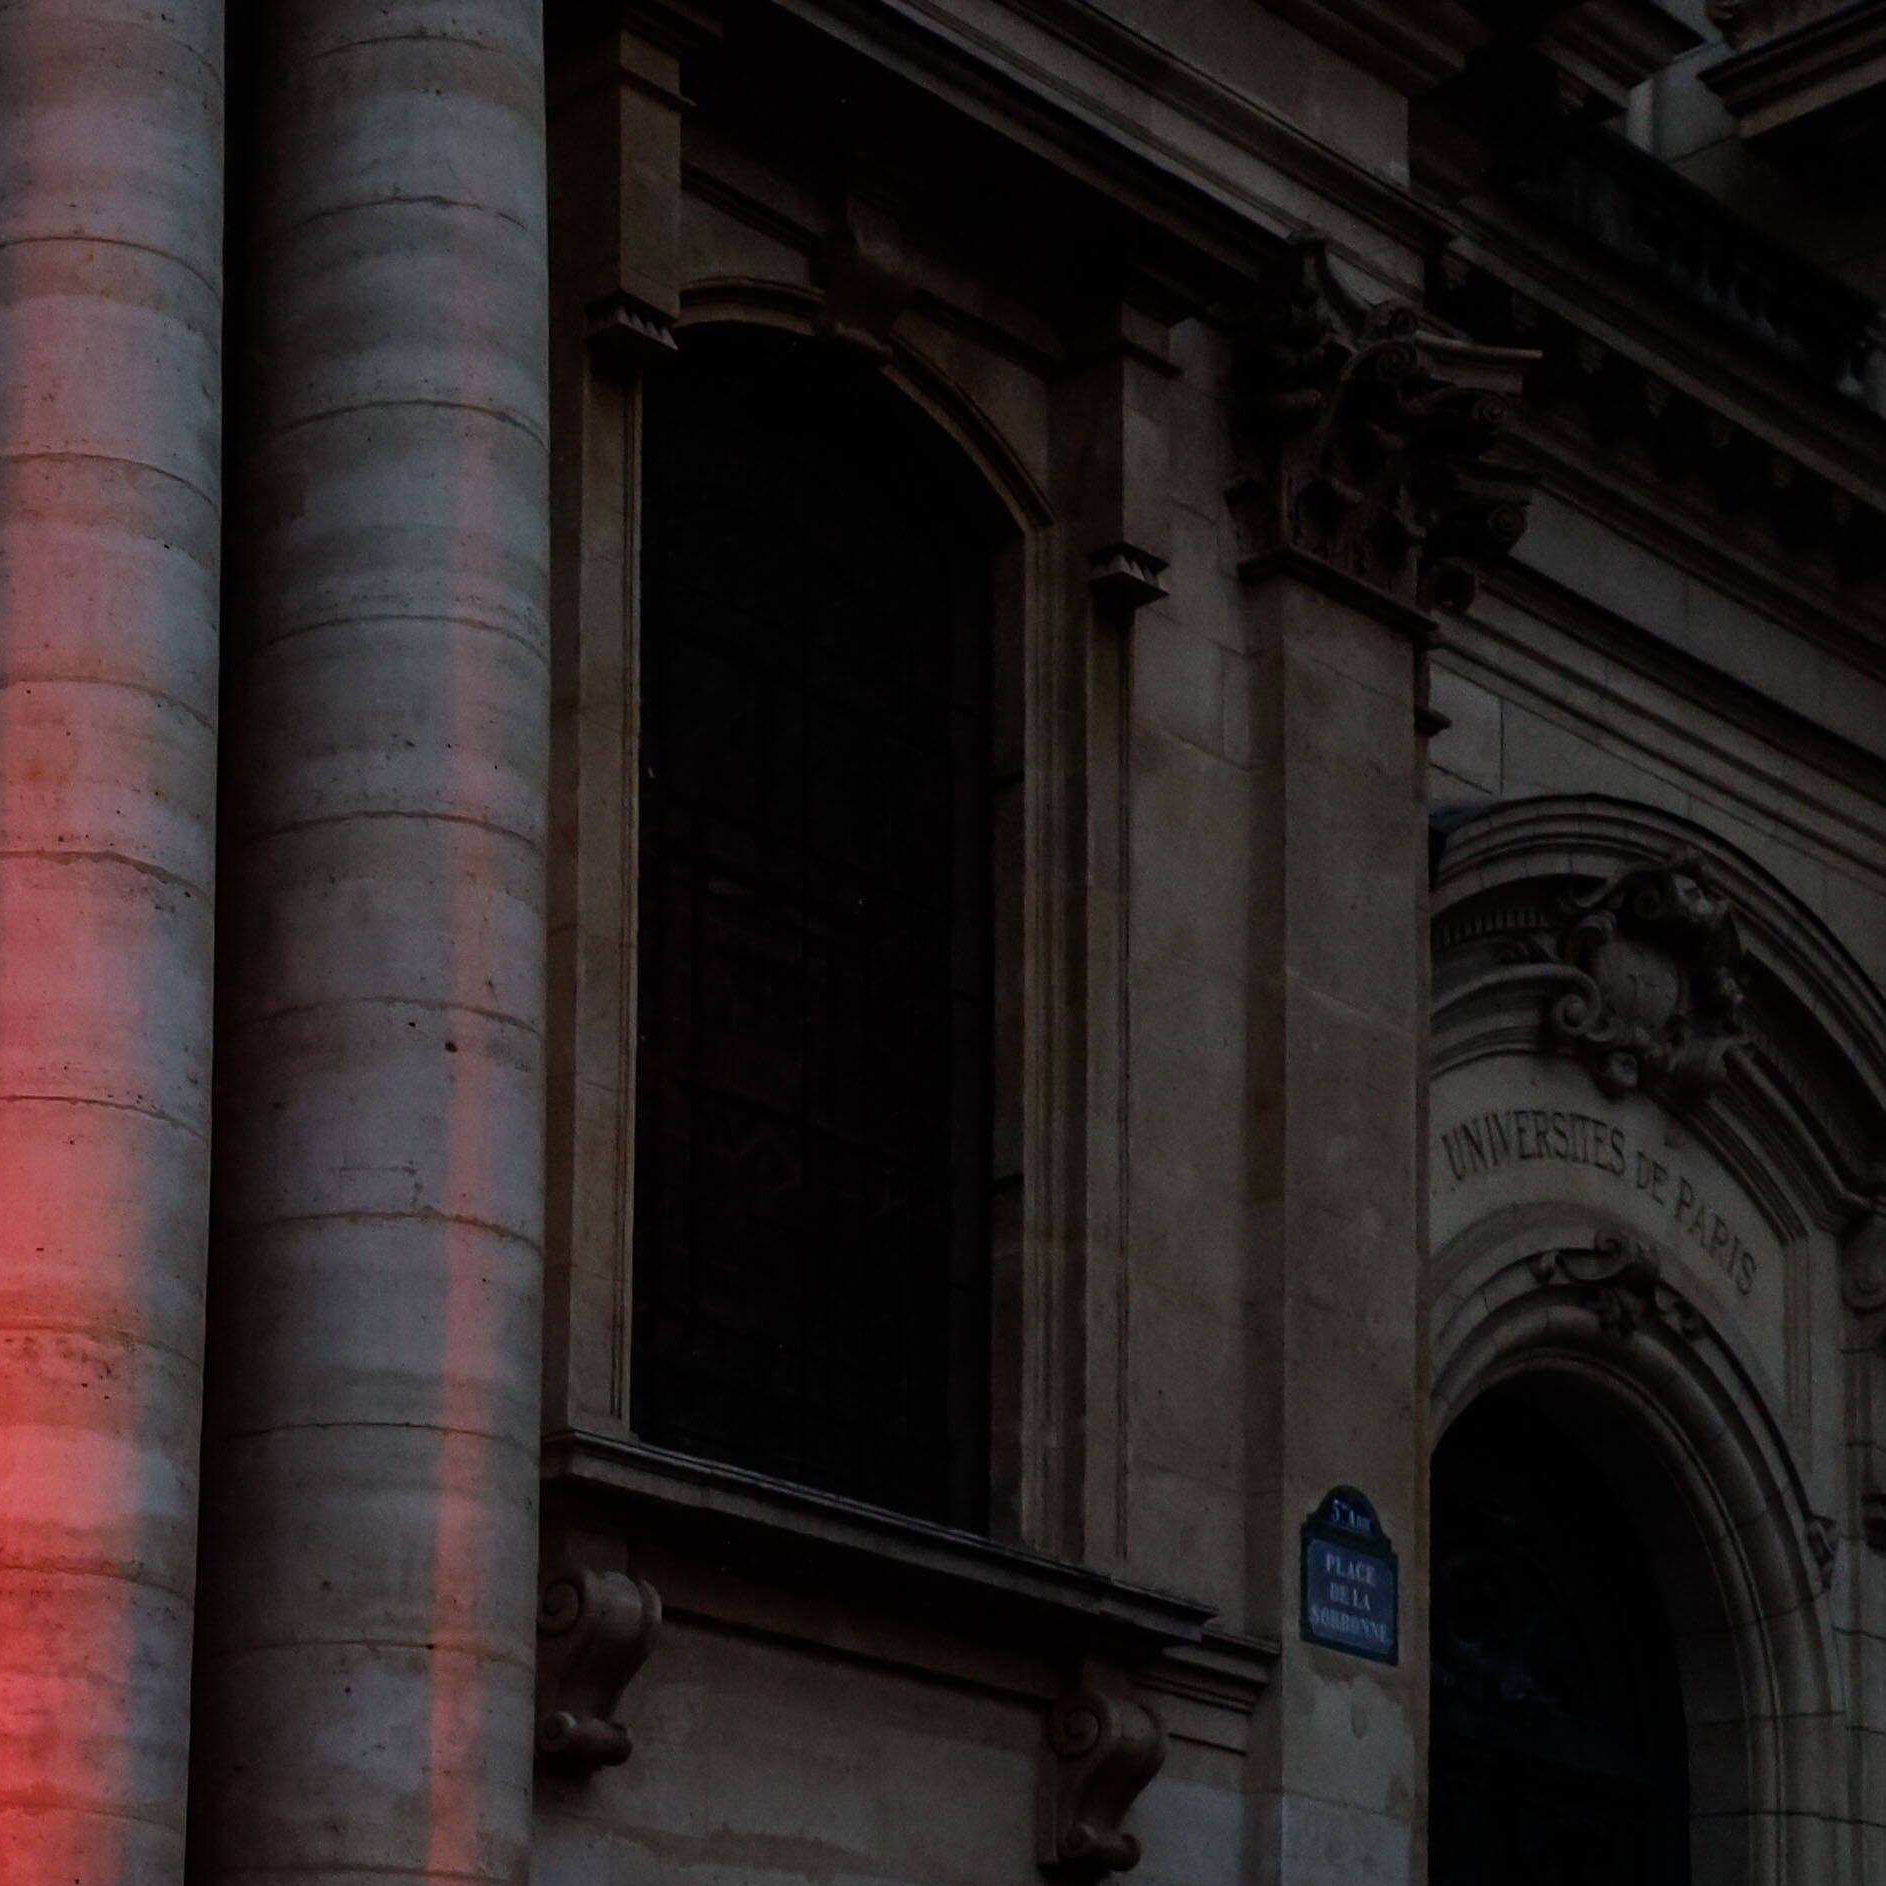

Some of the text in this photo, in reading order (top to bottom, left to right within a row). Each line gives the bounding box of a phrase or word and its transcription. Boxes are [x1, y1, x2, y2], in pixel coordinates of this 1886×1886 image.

[1442, 1109, 1757, 1296] UNIVERSITES DE PARIS
[1326, 1553, 1376, 1586] PLACE
[1353, 1587, 1371, 1612] LA
